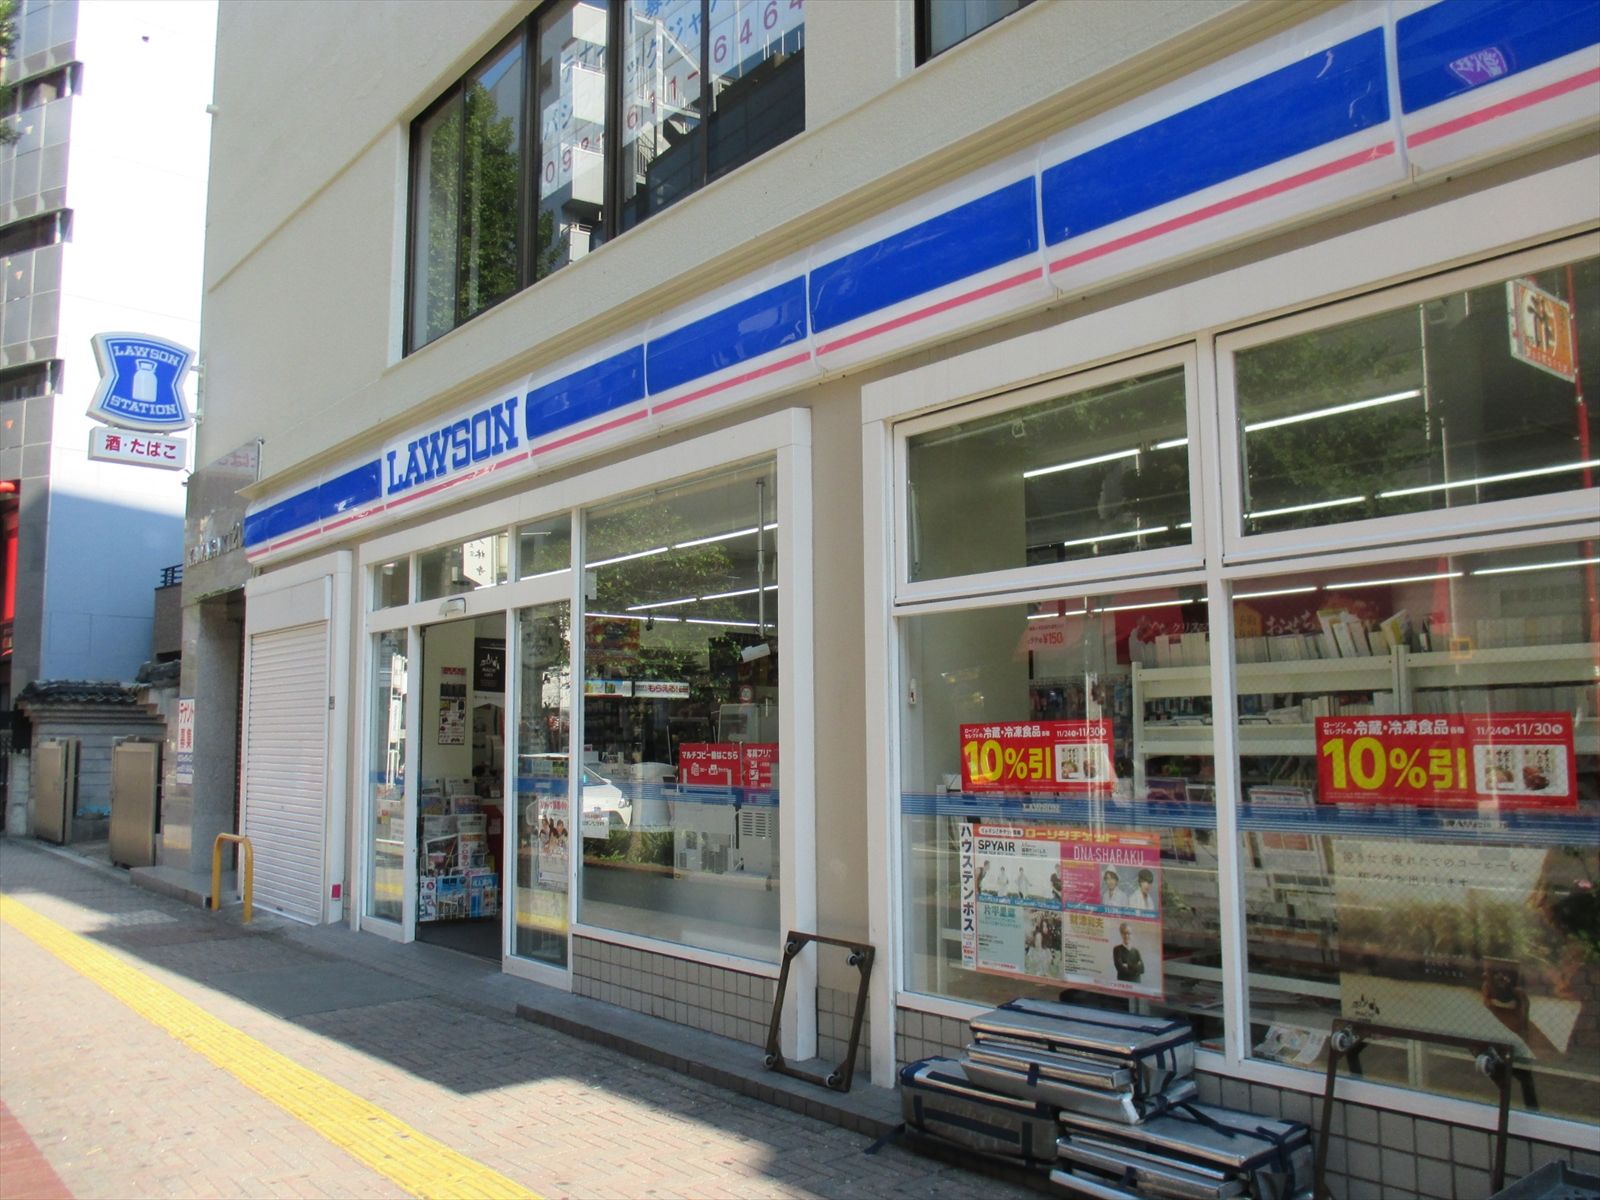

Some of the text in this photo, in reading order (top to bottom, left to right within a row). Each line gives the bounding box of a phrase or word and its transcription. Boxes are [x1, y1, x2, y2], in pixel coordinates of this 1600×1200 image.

[113, 345, 180, 366] LAWSON
[109, 395, 178, 415] STATION
[104, 434, 177, 459] 酒・たばこ
[386, 396, 519, 495] LAWSON
[978, 839, 1016, 852] SPYAIR
[960, 826, 975, 932] ハウステンボス
